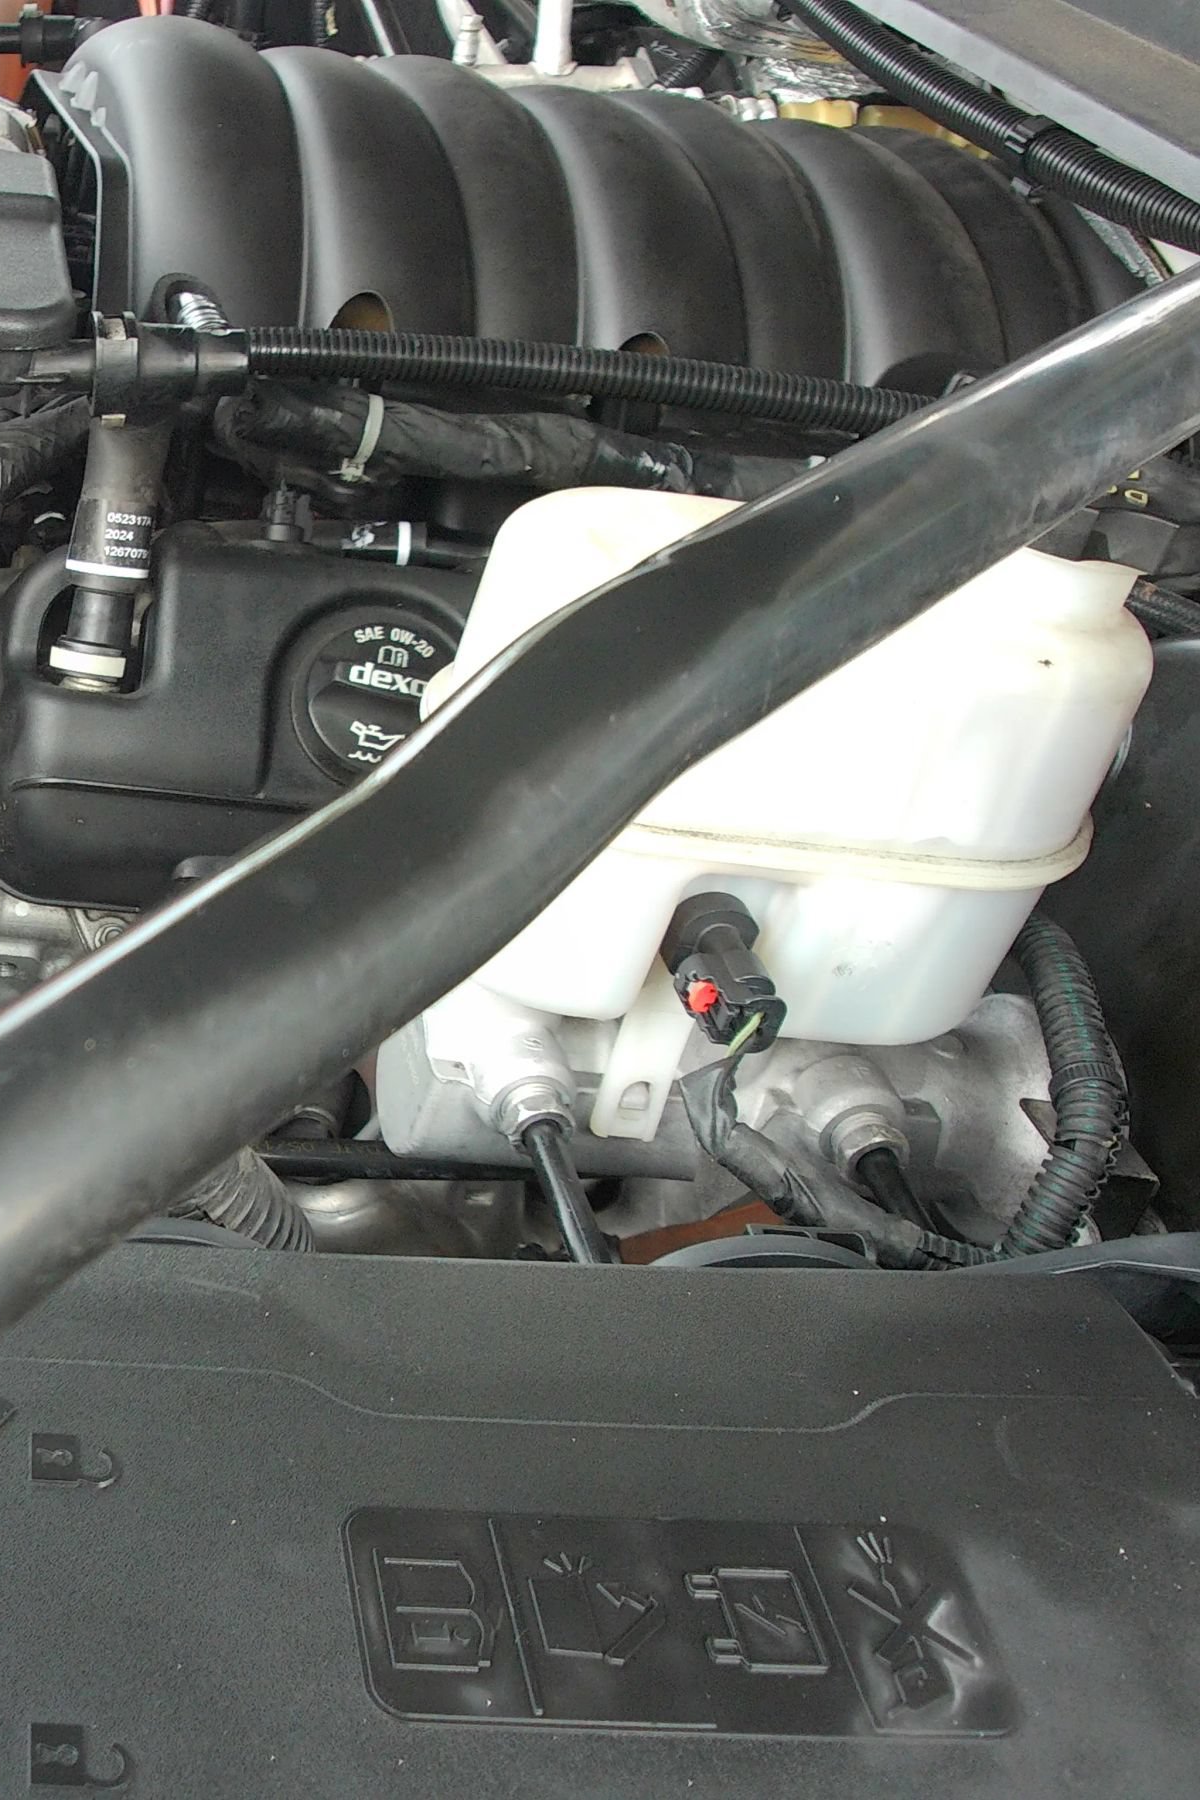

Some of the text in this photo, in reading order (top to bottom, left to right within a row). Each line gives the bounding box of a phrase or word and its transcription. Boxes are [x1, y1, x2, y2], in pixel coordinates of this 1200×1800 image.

[104, 528, 134, 541] 2024
[354, 626, 436, 658] SAE 0W-20
